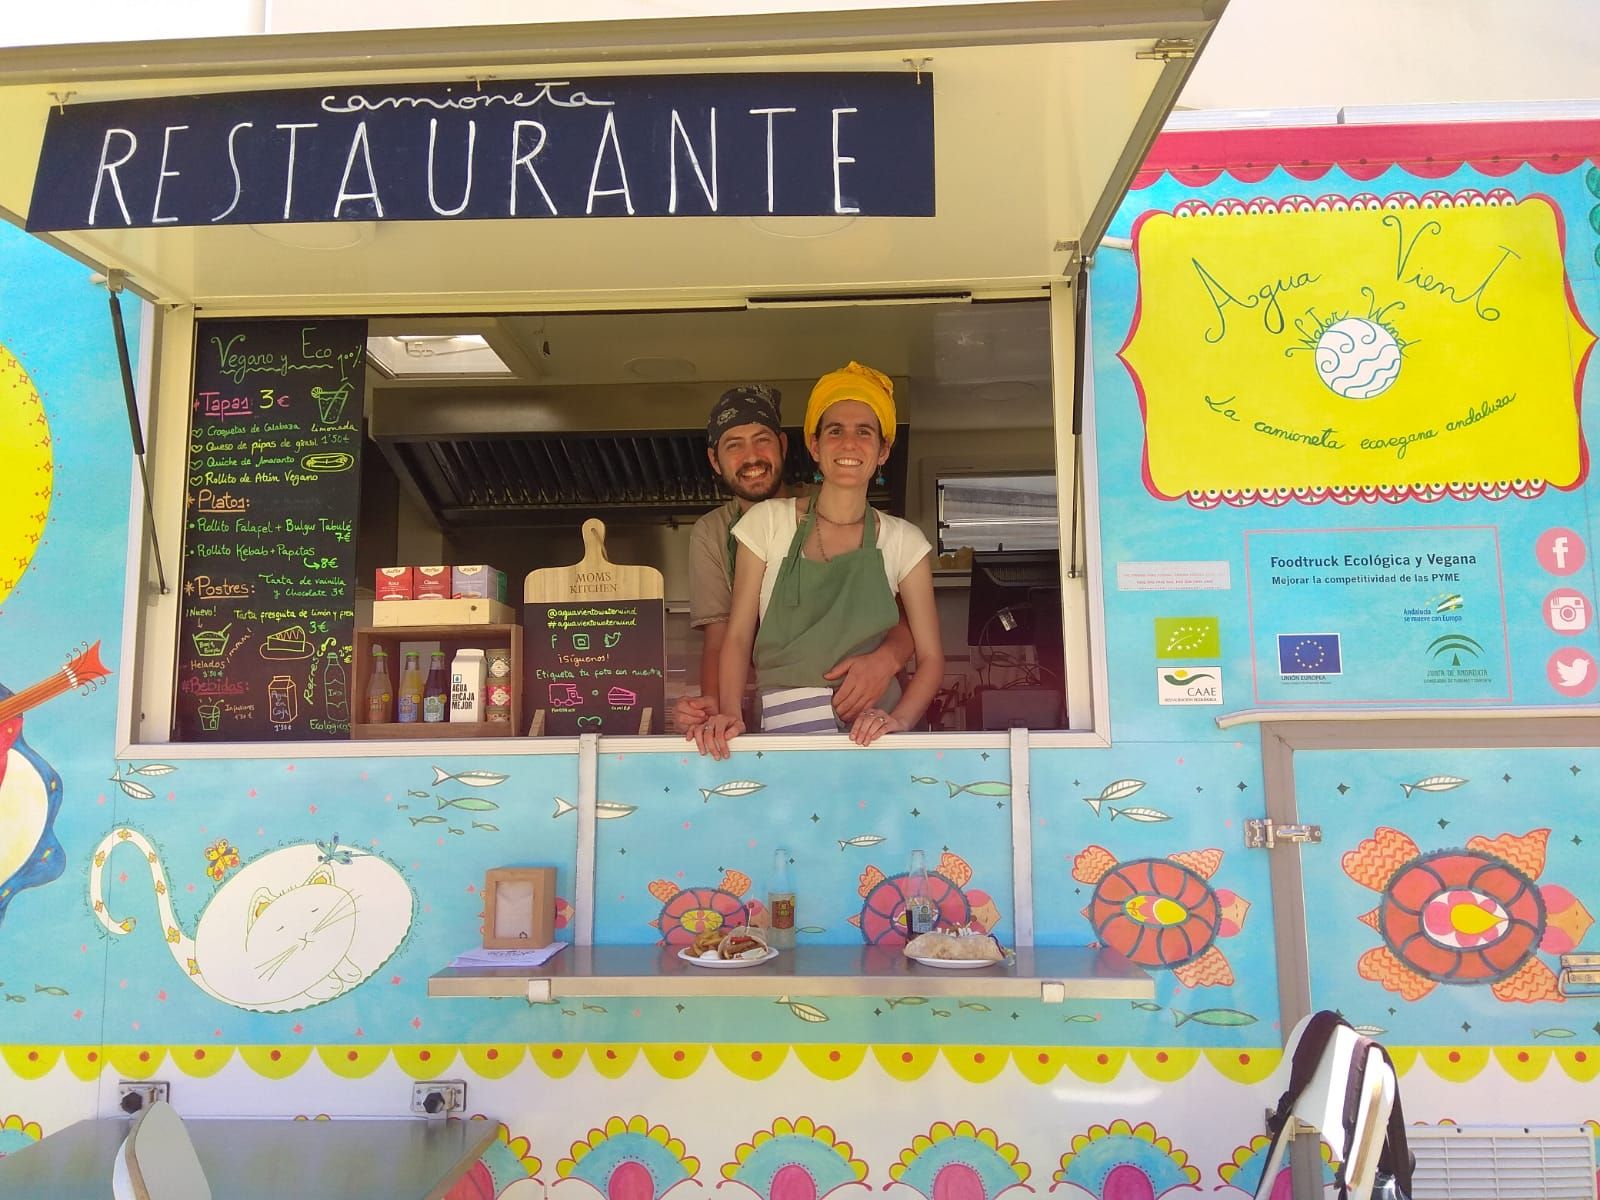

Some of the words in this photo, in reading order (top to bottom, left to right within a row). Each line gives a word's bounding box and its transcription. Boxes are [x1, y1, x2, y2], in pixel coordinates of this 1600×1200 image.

[321, 81, 615, 113] camioneta
[87, 107, 863, 227] RESTAURANTE
[1192, 257, 1322, 343] Agua
[211, 335, 274, 384] Vegano
[281, 354, 288, 376] y
[302, 327, 332, 359] Eco
[260, 389, 274, 409] 3
[207, 424, 247, 438] Croquetas
[250, 424, 260, 434] de
[311, 420, 358, 433] Limonada
[1205, 396, 1240, 422] La
[1254, 421, 1345, 450] camioneta
[1360, 430, 1439, 460] ecovegana
[1446, 393, 1517, 432] andaluza
[205, 441, 234, 452] Queso
[237, 439, 248, 449] de
[251, 438, 277, 456] pipas
[280, 438, 292, 448] de
[206, 456, 238, 468] Quiche
[240, 455, 252, 466] de
[205, 471, 237, 485] Rollito
[240, 471, 251, 483] de
[284, 469, 319, 486] Vegano
[197, 517, 230, 532] Rollito
[235, 518, 273, 538] Falafel
[318, 517, 352, 532] Tabulé
[197, 543, 232, 558] Rollito
[1271, 555, 1339, 568] Foodtruck
[1344, 554, 1411, 569] Ecológica
[1415, 556, 1423, 568] y
[1427, 553, 1477, 568] Vegana
[258, 573, 294, 585] Tarta
[299, 575, 313, 586] de
[1272, 575, 1310, 587] Mejorar
[1312, 575, 1322, 584] la
[1324, 574, 1397, 586] competitividad
[1399, 573, 1412, 583] de
[1414, 573, 1429, 583] las
[1431, 573, 1460, 583] PYME
[273, 589, 281, 600] y
[569, 583, 618, 595] KITCHEN
[233, 609, 258, 620] Tarta
[298, 608, 308, 619] de
[190, 660, 226, 671] Helados
[451, 683, 468, 693] AGUA
[1187, 687, 1217, 697] CAAE
[451, 701, 473, 711] MEJOR
